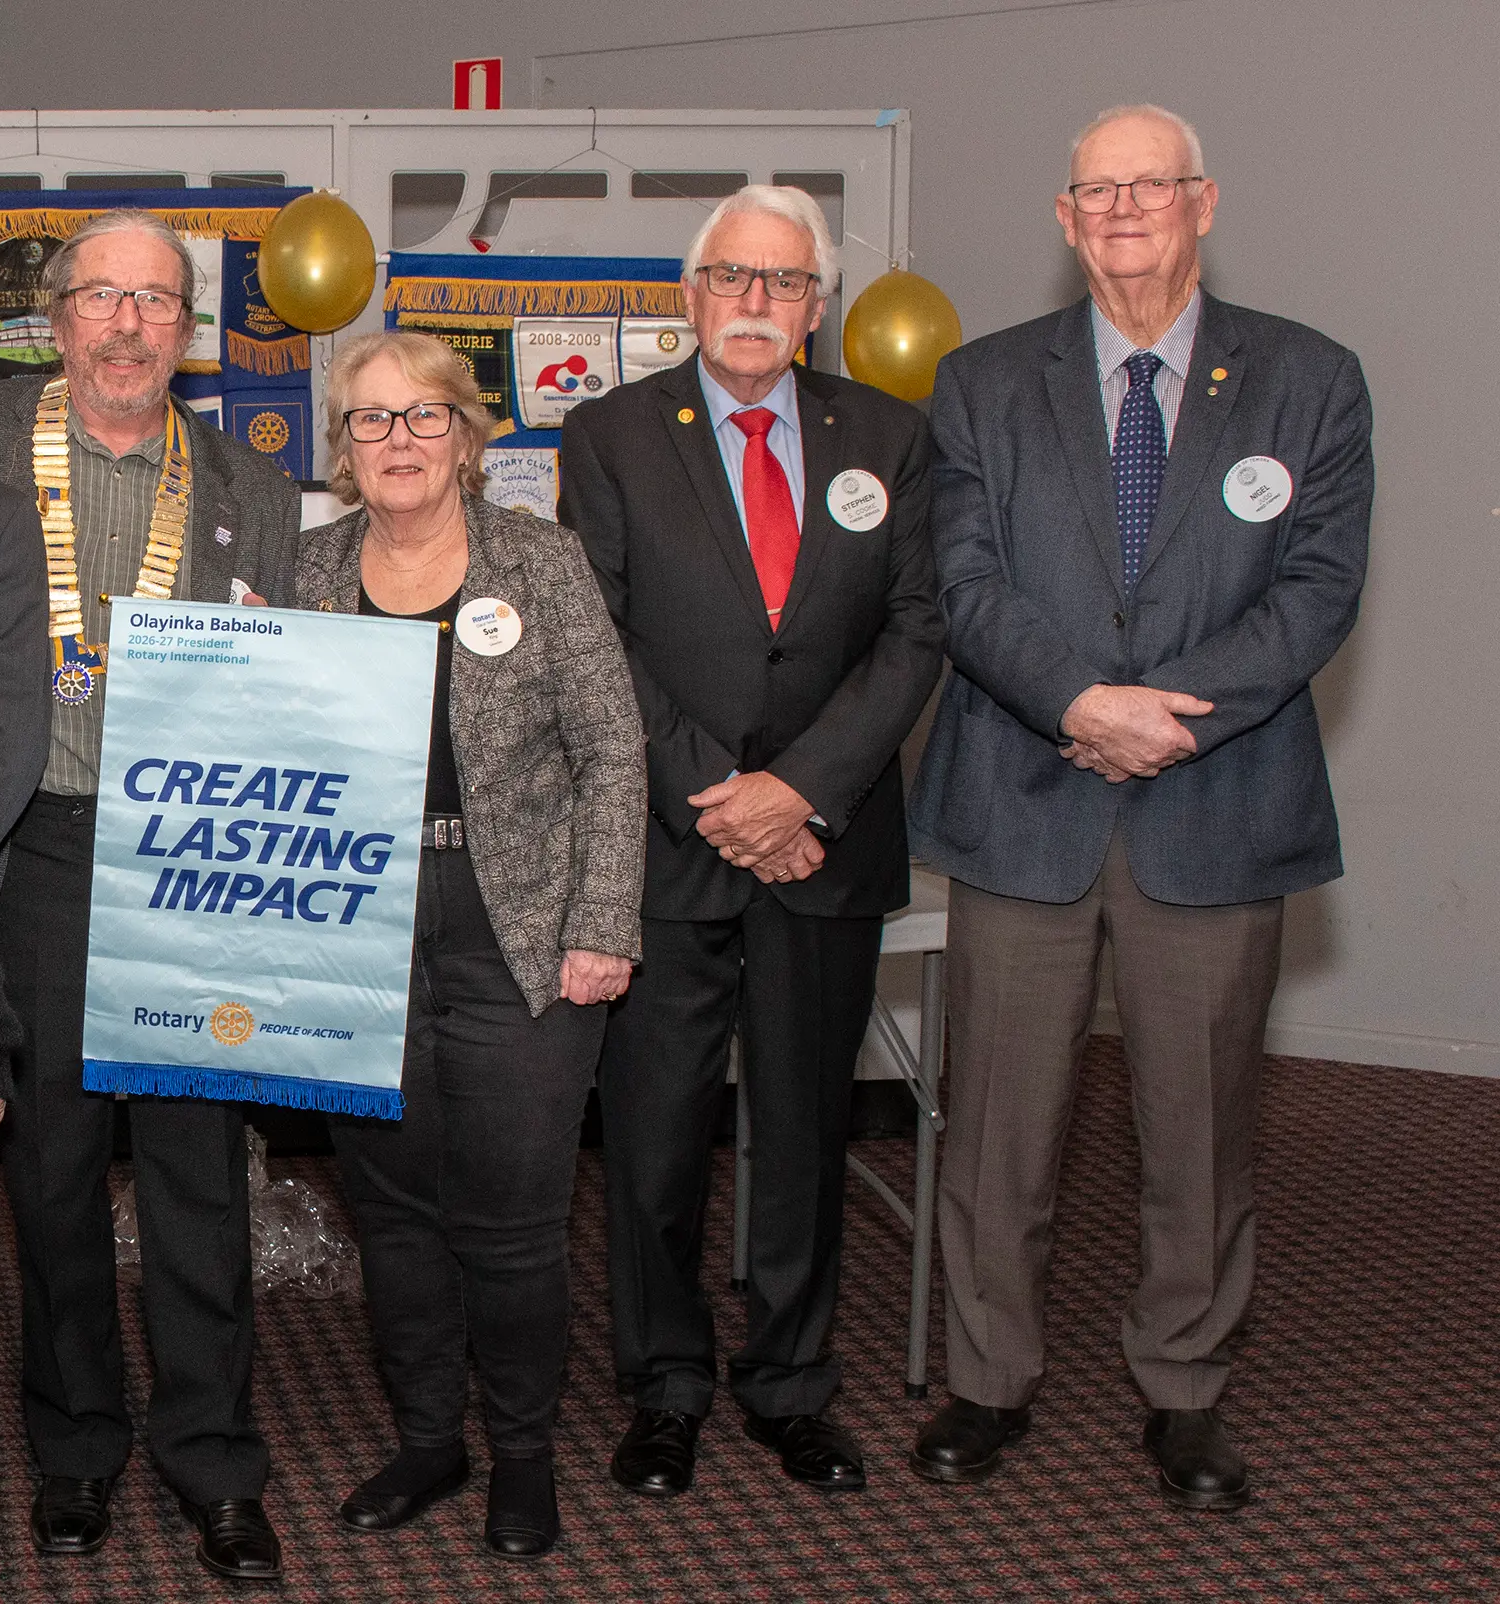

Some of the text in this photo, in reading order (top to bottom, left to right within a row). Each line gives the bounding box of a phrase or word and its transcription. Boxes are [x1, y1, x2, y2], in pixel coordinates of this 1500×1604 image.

[437, 335, 495, 349] VERURIE
[529, 332, 601, 347] 2008-2009
[484, 458, 553, 473] ROTARY CLUB
[1249, 484, 1271, 501] NIGEL
[841, 492, 876, 512] STEPHEN
[129, 613, 283, 636] Olayinka Babalola
[472, 612, 495, 623] Rotary
[482, 626, 499, 636] Sue
[128, 634, 235, 650] 2026-27 President
[127, 649, 250, 666] Rotary International
[123, 757, 349, 817] CREATE
[135, 814, 395, 875] LASTING
[147, 868, 376, 925] IMPACT
[133, 1006, 354, 1041] Rotary PEOPLE OF ACTION
